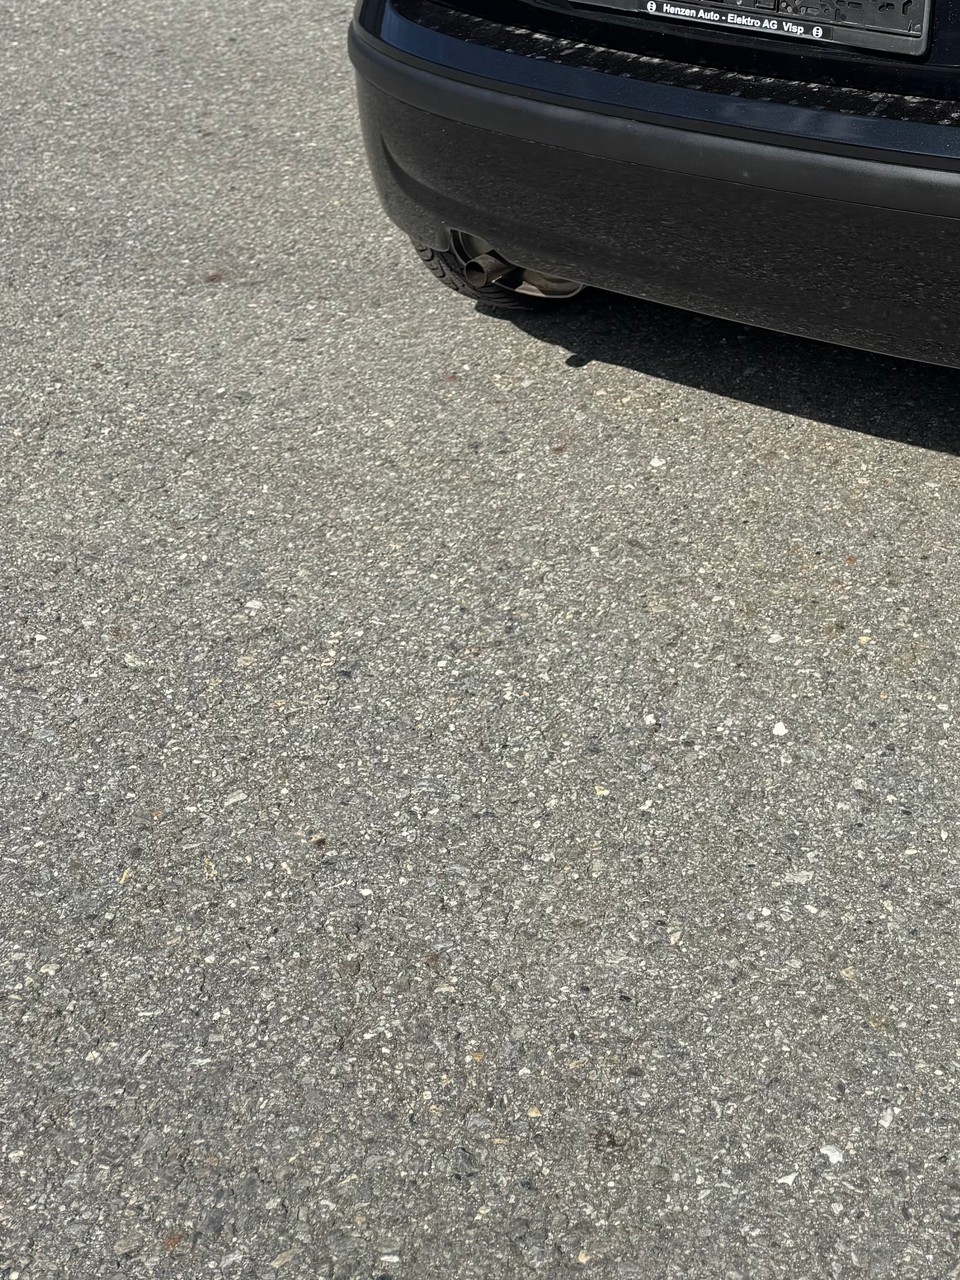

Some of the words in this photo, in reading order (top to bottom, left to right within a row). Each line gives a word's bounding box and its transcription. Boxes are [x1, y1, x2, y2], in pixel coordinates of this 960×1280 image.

[663, 3, 697, 18] Henzen
[698, 9, 720, 21] Auto
[727, 13, 761, 28] Elektro
[762, 19, 778, 30] AG
[783, 21, 804, 35] Visp
